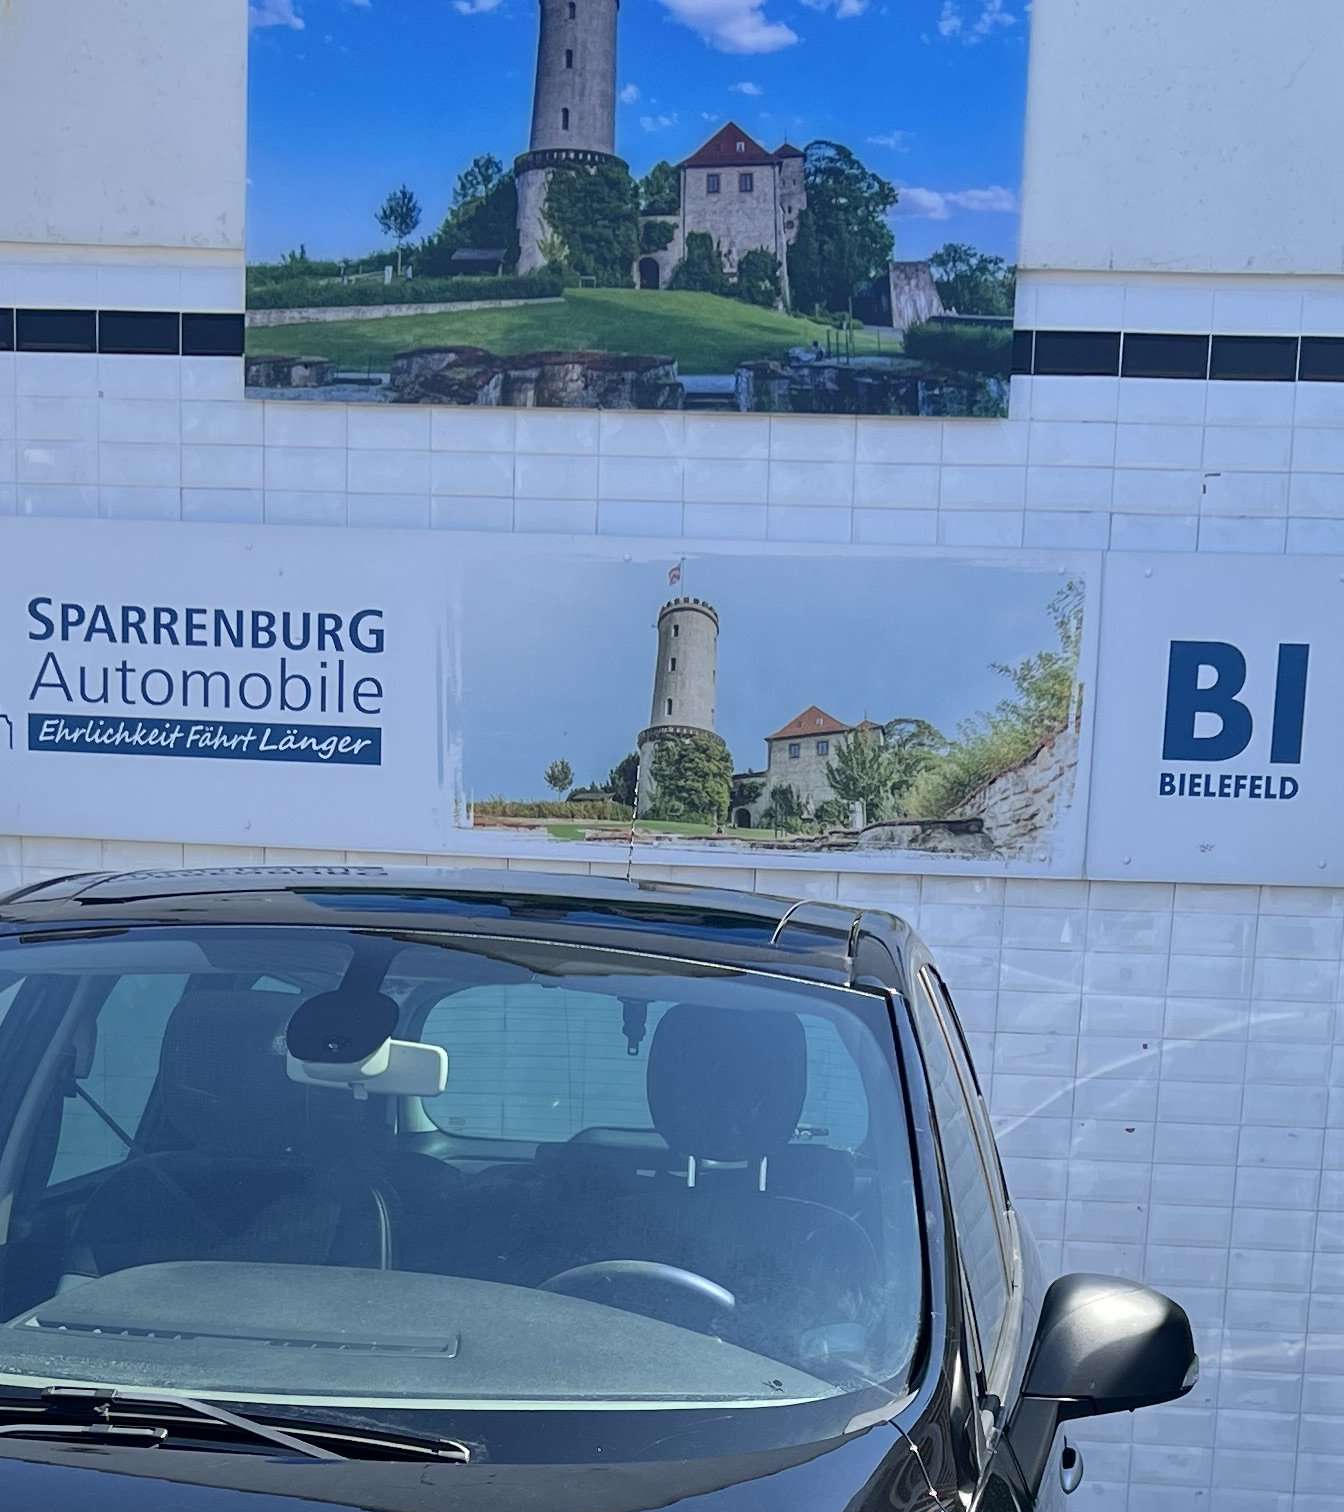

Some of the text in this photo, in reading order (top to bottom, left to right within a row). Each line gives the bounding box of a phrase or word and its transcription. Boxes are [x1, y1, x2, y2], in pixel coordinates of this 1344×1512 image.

[27, 596, 386, 653] SPARRENBURG
[27, 651, 385, 715] Automobile
[1161, 639, 1311, 765] BI
[38, 719, 373, 761] Ehrlichkeit Fährt Länger
[1159, 772, 1300, 800] BIELEFELD
